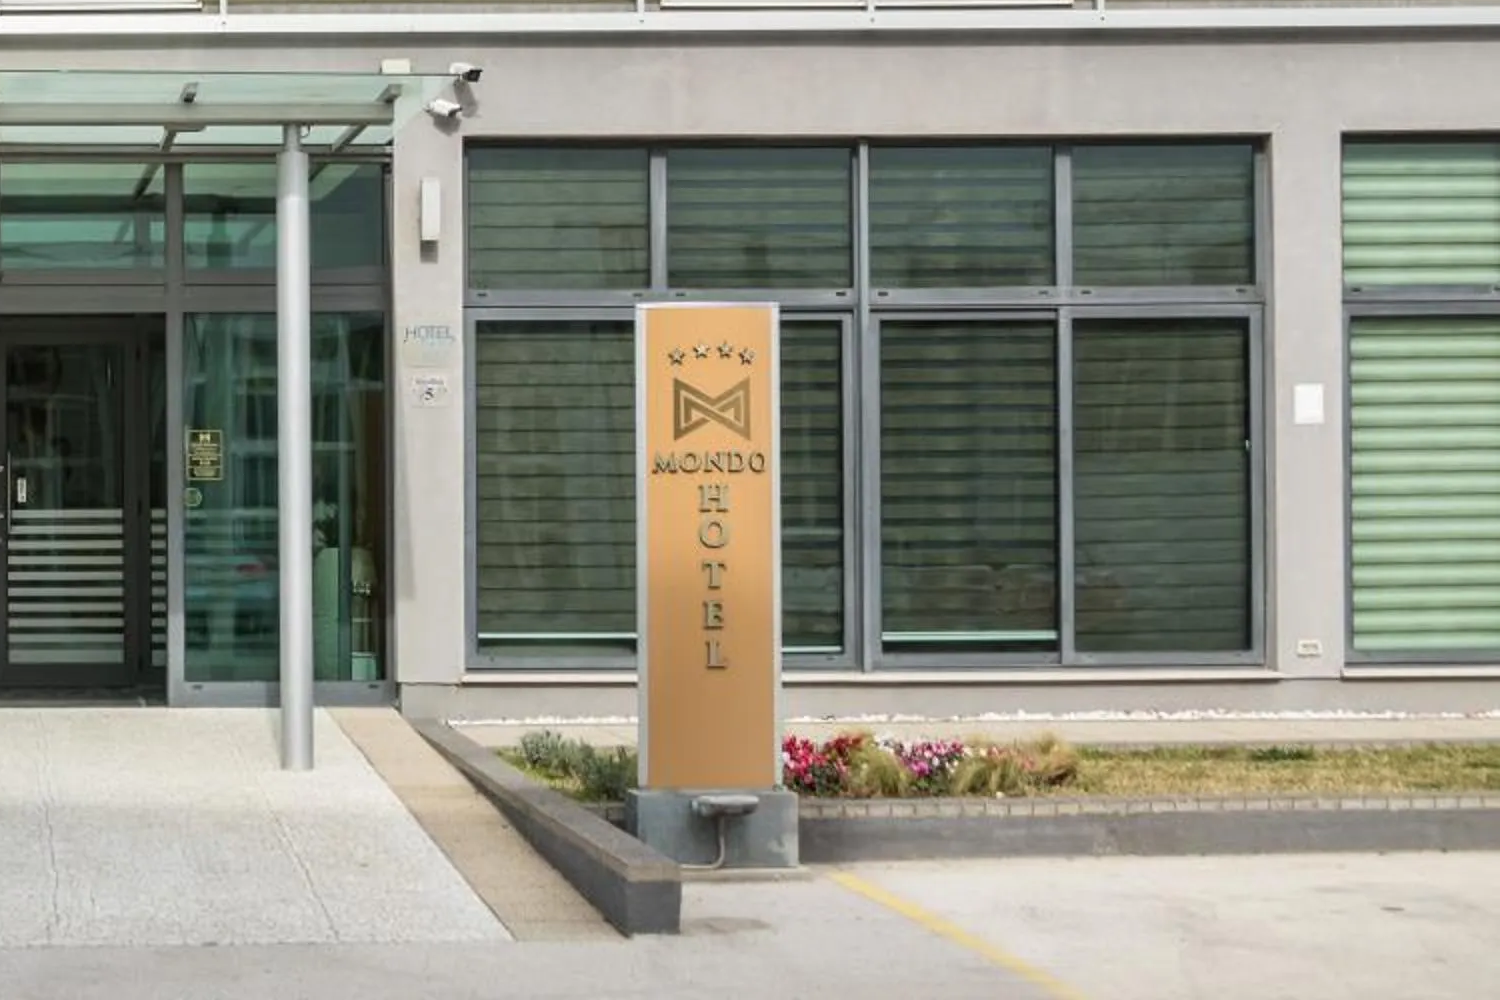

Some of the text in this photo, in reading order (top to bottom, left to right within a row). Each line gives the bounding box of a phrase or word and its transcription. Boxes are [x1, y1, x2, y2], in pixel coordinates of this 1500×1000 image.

[404, 324, 454, 341] HOTEL
[651, 451, 766, 474] MONDO
[698, 484, 730, 670] HOTEL
